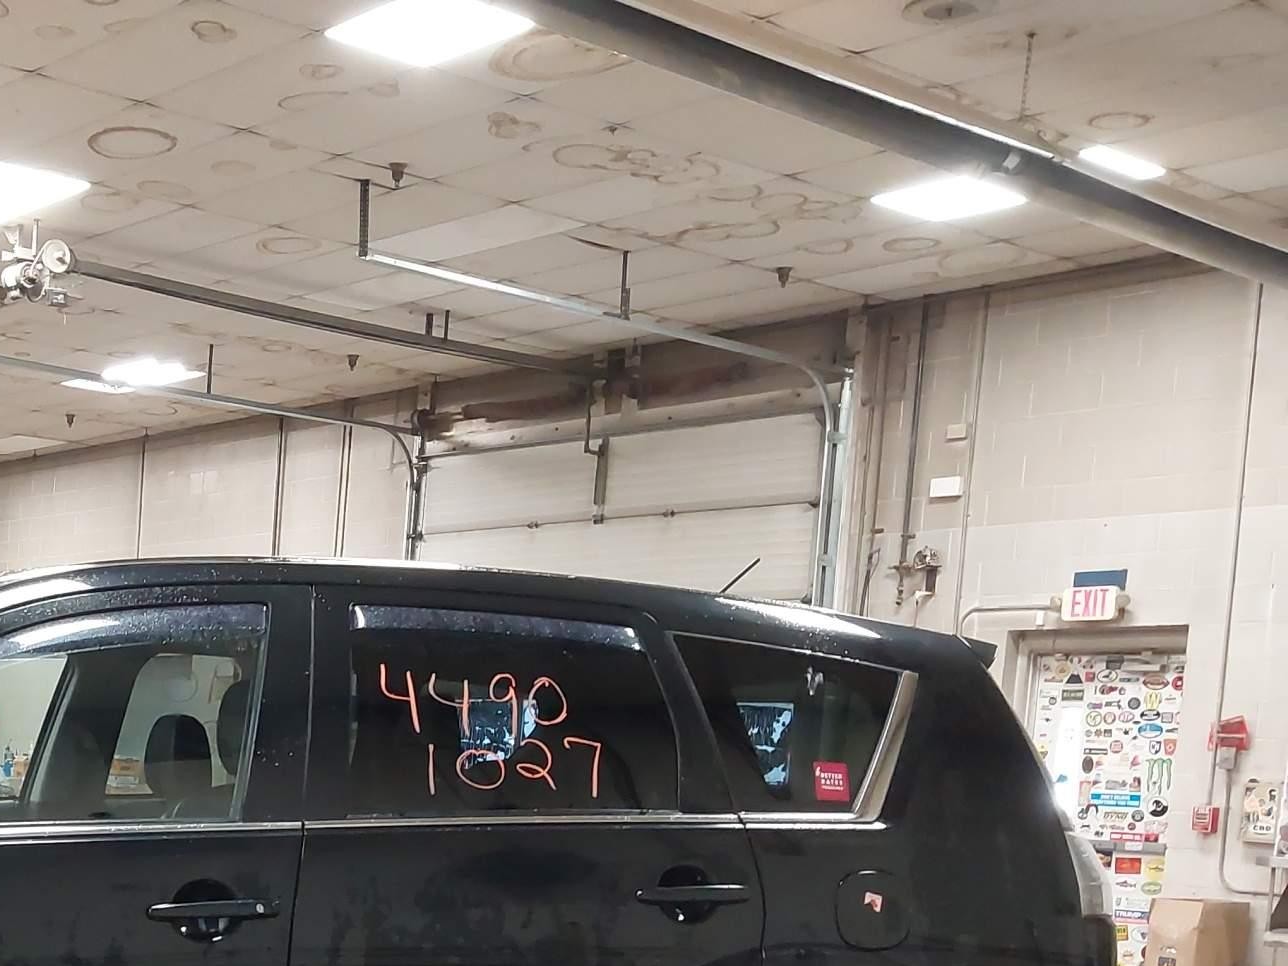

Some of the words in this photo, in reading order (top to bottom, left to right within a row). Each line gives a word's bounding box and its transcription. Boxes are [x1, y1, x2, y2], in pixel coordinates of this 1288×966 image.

[1071, 589, 1110, 617] EXIT
[379, 662, 568, 737] 4490
[428, 737, 602, 798] 1027
[1116, 911, 1141, 919] TRUMP
